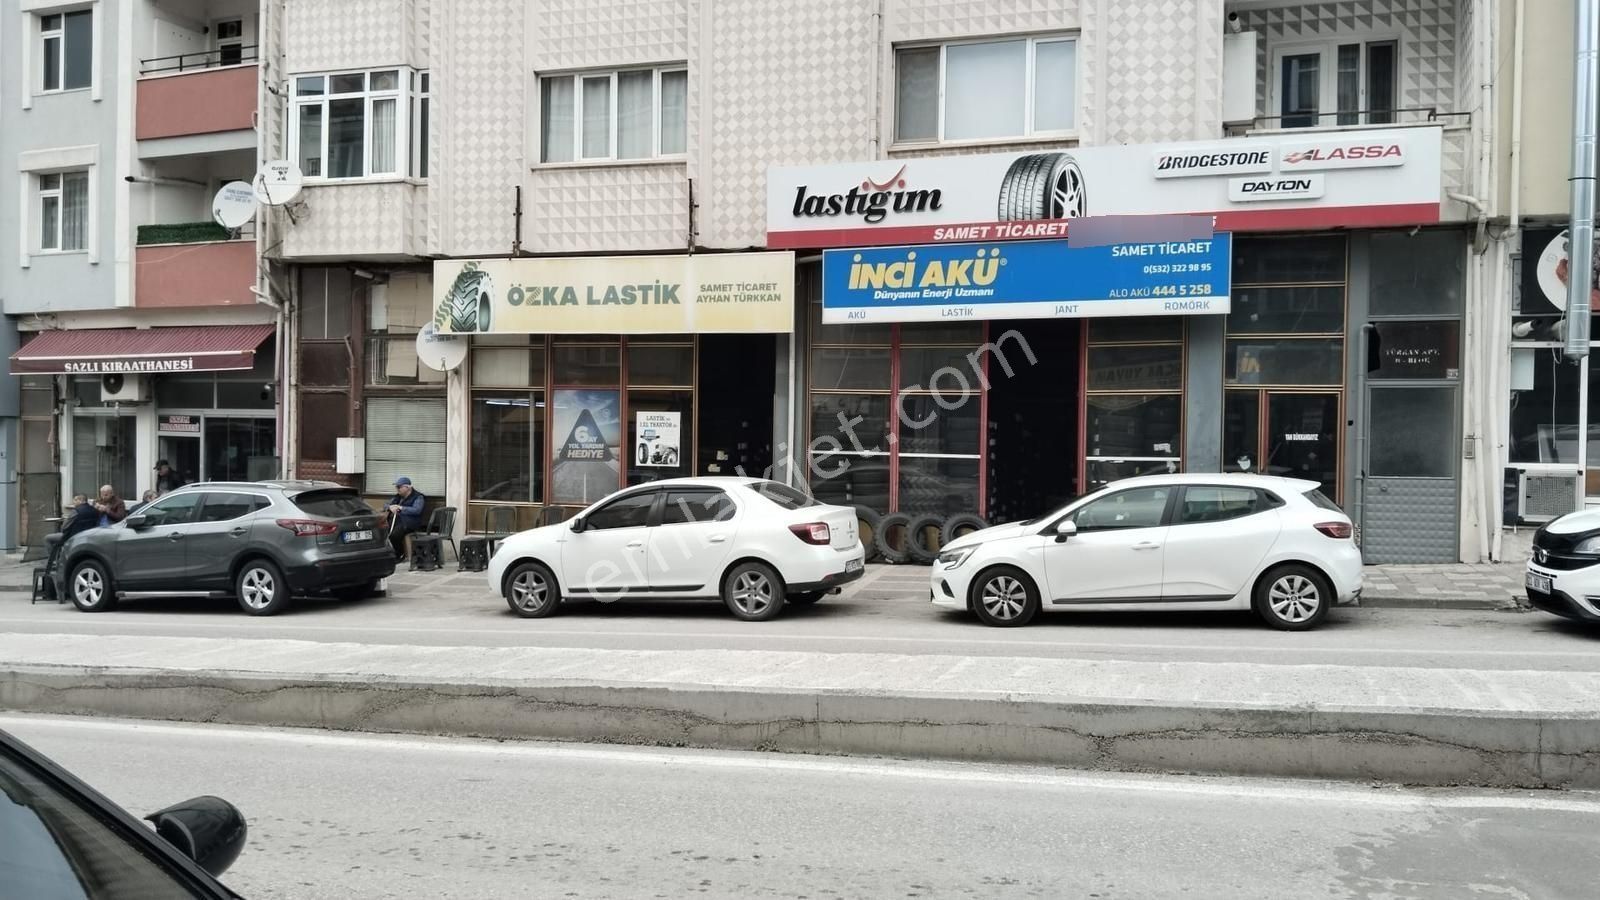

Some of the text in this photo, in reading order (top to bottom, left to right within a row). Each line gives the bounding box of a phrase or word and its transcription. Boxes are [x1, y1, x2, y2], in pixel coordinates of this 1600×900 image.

[1312, 144, 1403, 162] LASSA
[1157, 151, 1270, 171] BRIDGESTONE
[1241, 179, 1312, 193] DAYTON
[933, 222, 1069, 241] SAMET TİCARET
[1111, 241, 1213, 257] SAMET TİCARET
[847, 251, 918, 290] İNCİ
[1143, 263, 1212, 275] 0(532) 322 98 95
[506, 279, 682, 307] ÖZKA LASTİK
[700, 281, 778, 293] SAMET TİCARET
[873, 287, 995, 301] Dünyanın Enerji Uzmanı
[1109, 288, 1129, 298] ALO
[1151, 285, 1177, 297] 444
[1178, 285, 1188, 296] 5
[1188, 284, 1213, 296] 258
[696, 293, 783, 304] AYHAN TÜRKKAN
[941, 307, 974, 318] LASTİK
[1054, 304, 1080, 315] JANT
[64, 357, 194, 373] SAZLI KIRAATHANESİ
[574, 425, 590, 443] 6
